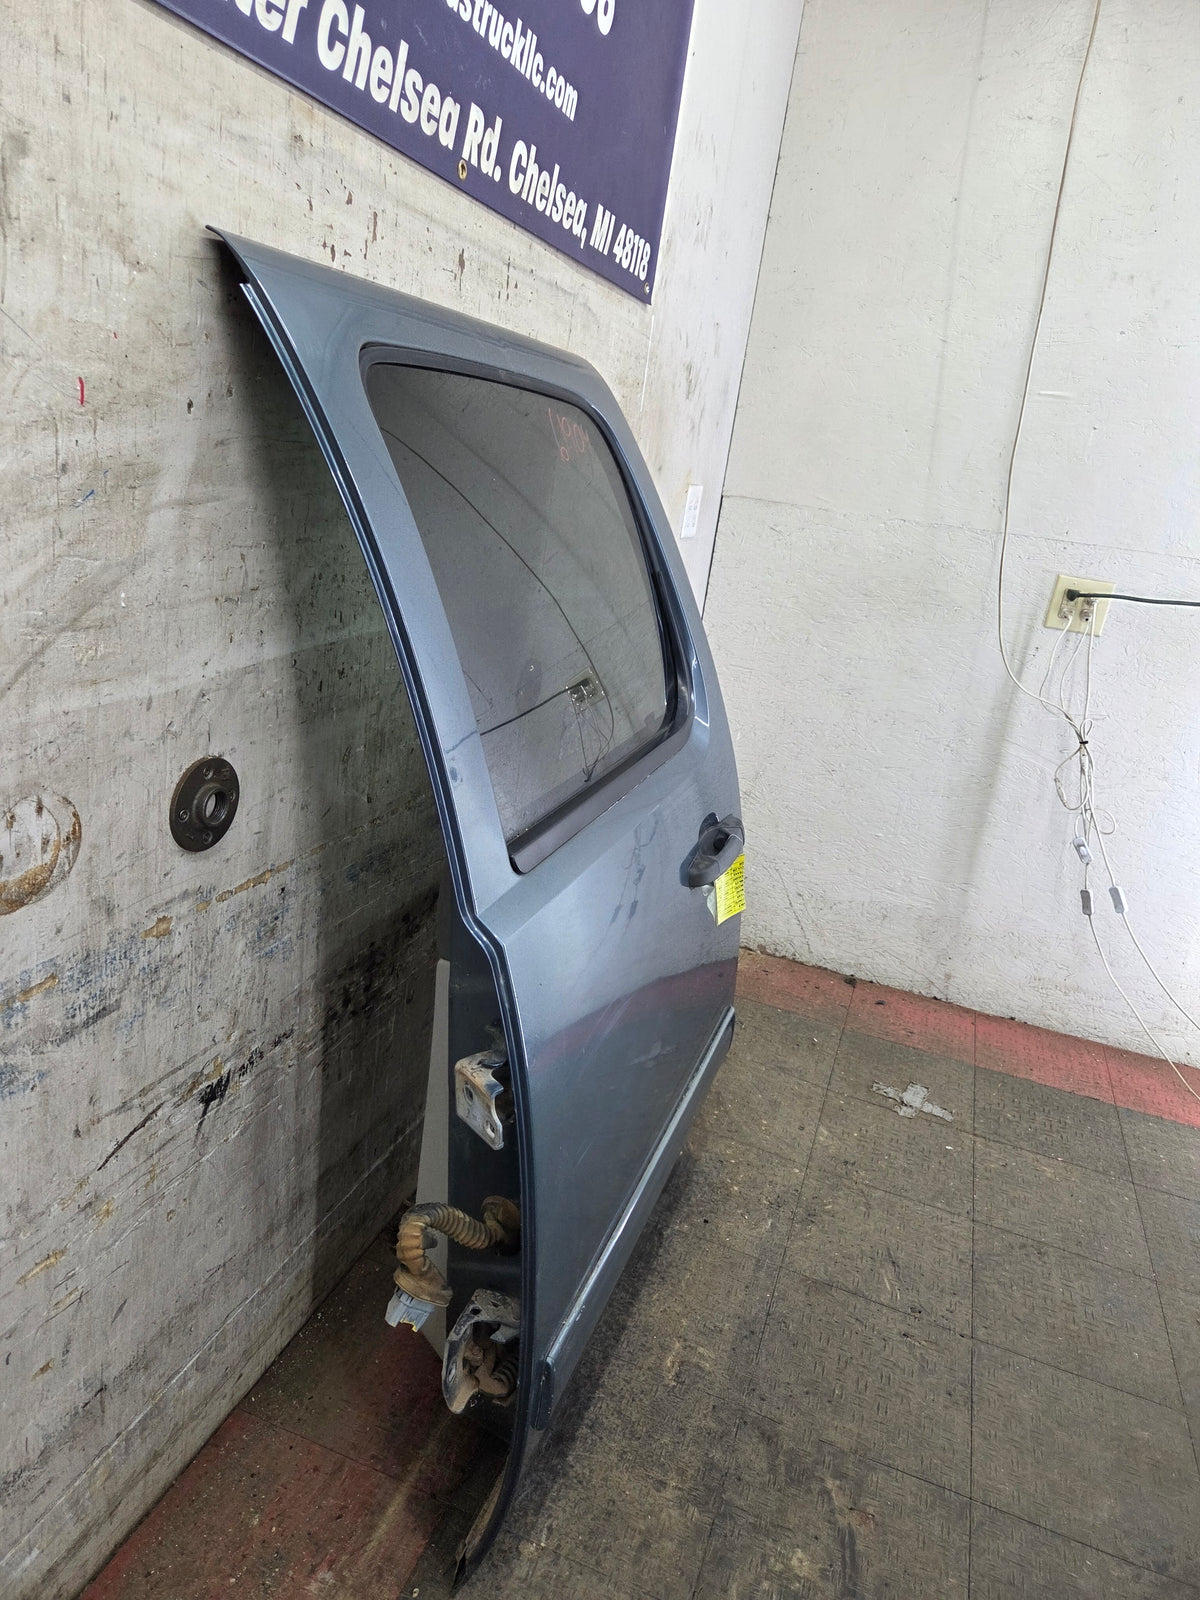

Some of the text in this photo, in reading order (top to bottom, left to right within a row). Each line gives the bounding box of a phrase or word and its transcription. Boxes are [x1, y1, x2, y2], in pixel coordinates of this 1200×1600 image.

[316, 0, 461, 151] Chelsea
[461, 102, 503, 183] Rd.
[508, 139, 588, 250] Chelsea,
[589, 203, 617, 256] MI
[612, 223, 651, 282] 48118
